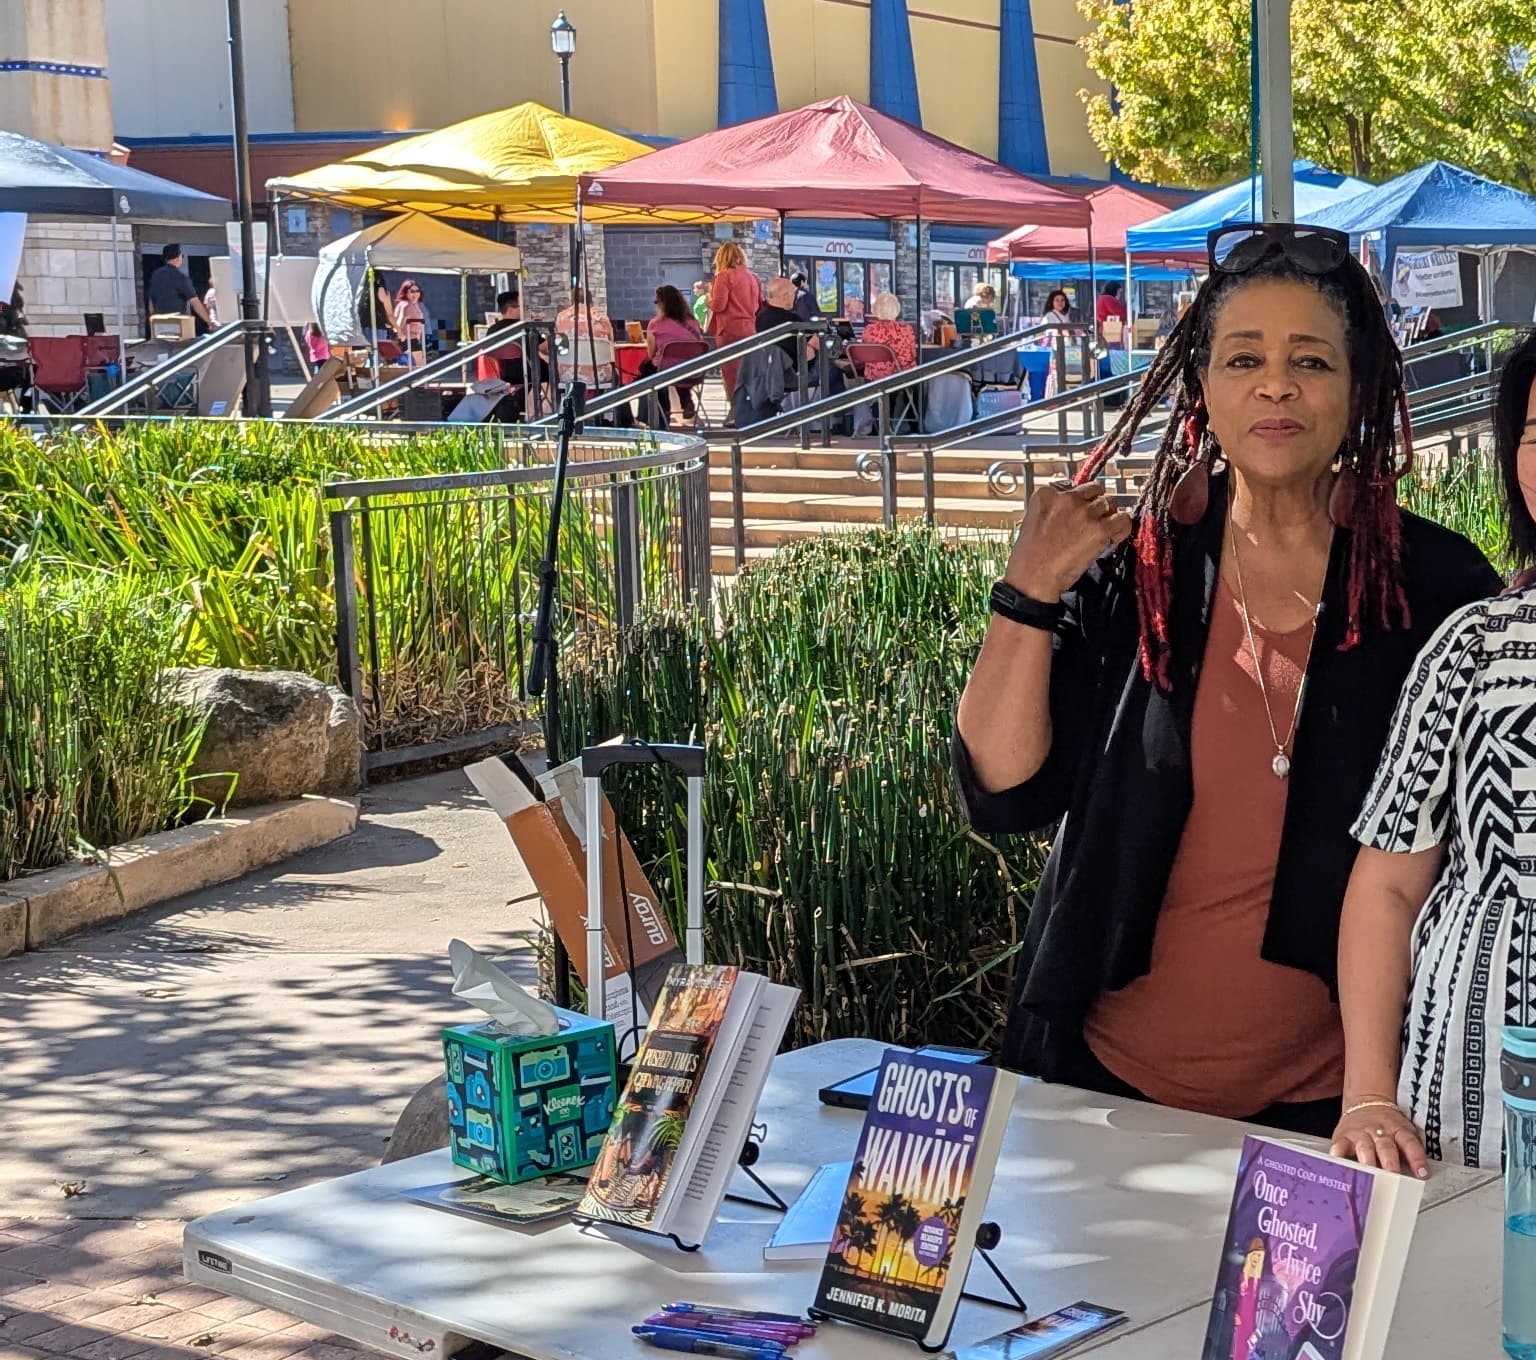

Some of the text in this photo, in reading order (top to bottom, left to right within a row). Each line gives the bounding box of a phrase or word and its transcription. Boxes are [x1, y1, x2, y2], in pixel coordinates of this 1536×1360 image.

[968, 248, 987, 259] am
[629, 893, 668, 945] auray
[543, 1095, 585, 1115] Kleenex
[877, 1062, 979, 1129] GHOSTS OF
[1253, 1170, 1288, 1207] Once
[1264, 1158, 1297, 1177] GHOSTED
[1318, 1176, 1352, 1193] MYSTERY
[1257, 1206, 1318, 1253] Ghosted,
[1278, 1242, 1322, 1285] Twice
[826, 1286, 927, 1324] JENNIFER K. MORITA
